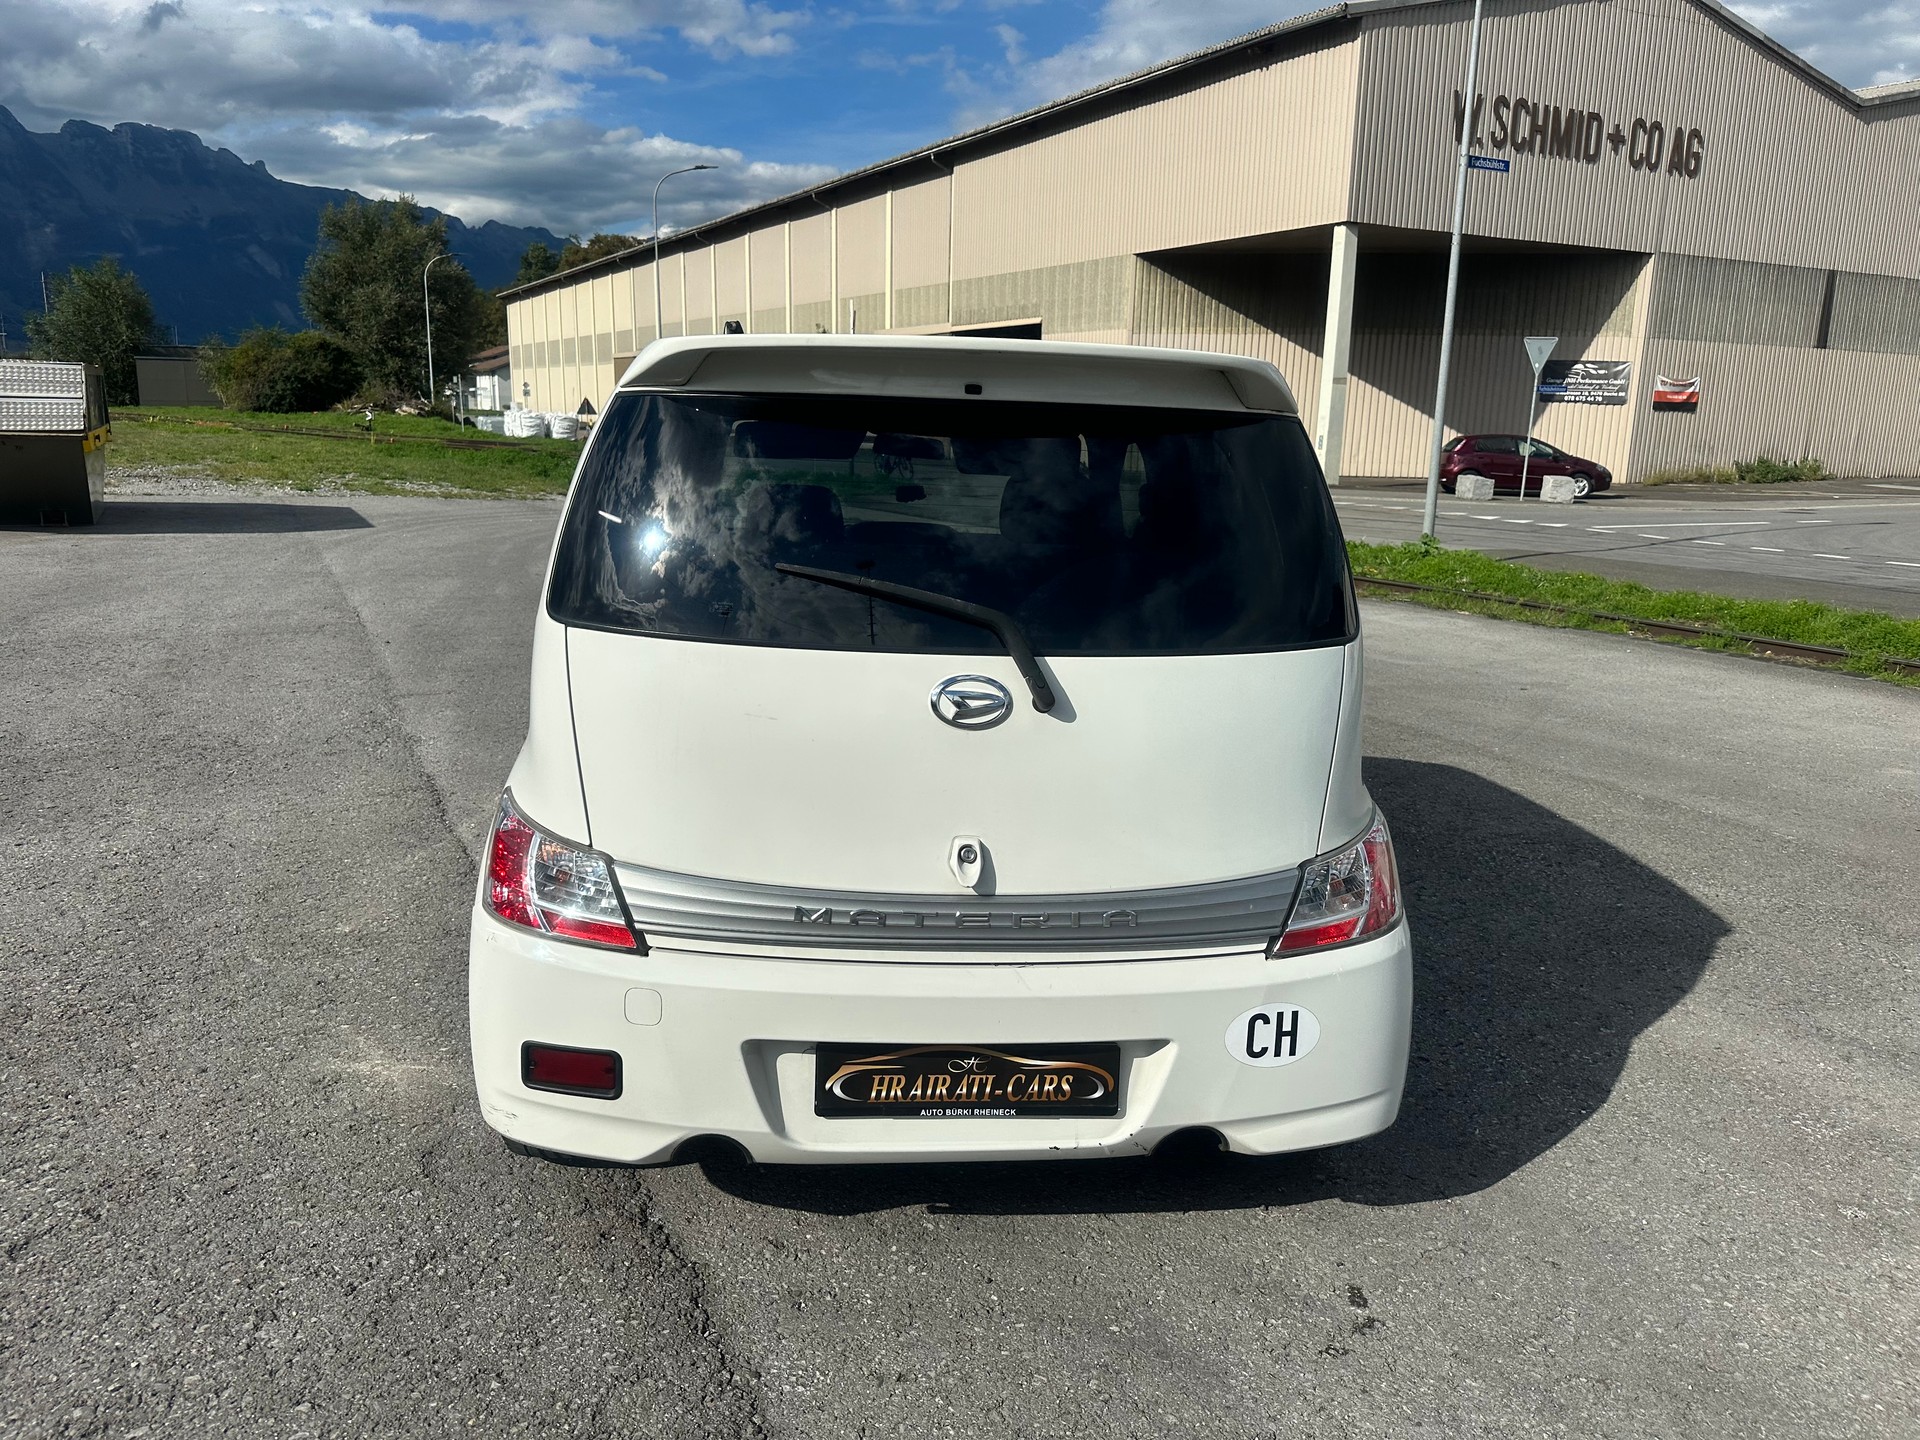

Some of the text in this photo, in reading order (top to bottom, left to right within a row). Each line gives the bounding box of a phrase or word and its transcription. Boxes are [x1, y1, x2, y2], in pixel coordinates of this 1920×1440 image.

[1491, 95, 1603, 164] SCHMID
[1628, 118, 1664, 173] CO
[1667, 127, 1704, 179] AG
[1471, 157, 1507, 170] Fuchsbühlstr.
[794, 905, 1137, 929] MATERIA
[1246, 1010, 1299, 1058] CH
[867, 1072, 1074, 1102] HRAIRATI-CARS
[945, 1107, 972, 1116] BÜRKI
[974, 1108, 1016, 1116] RHEINECK
